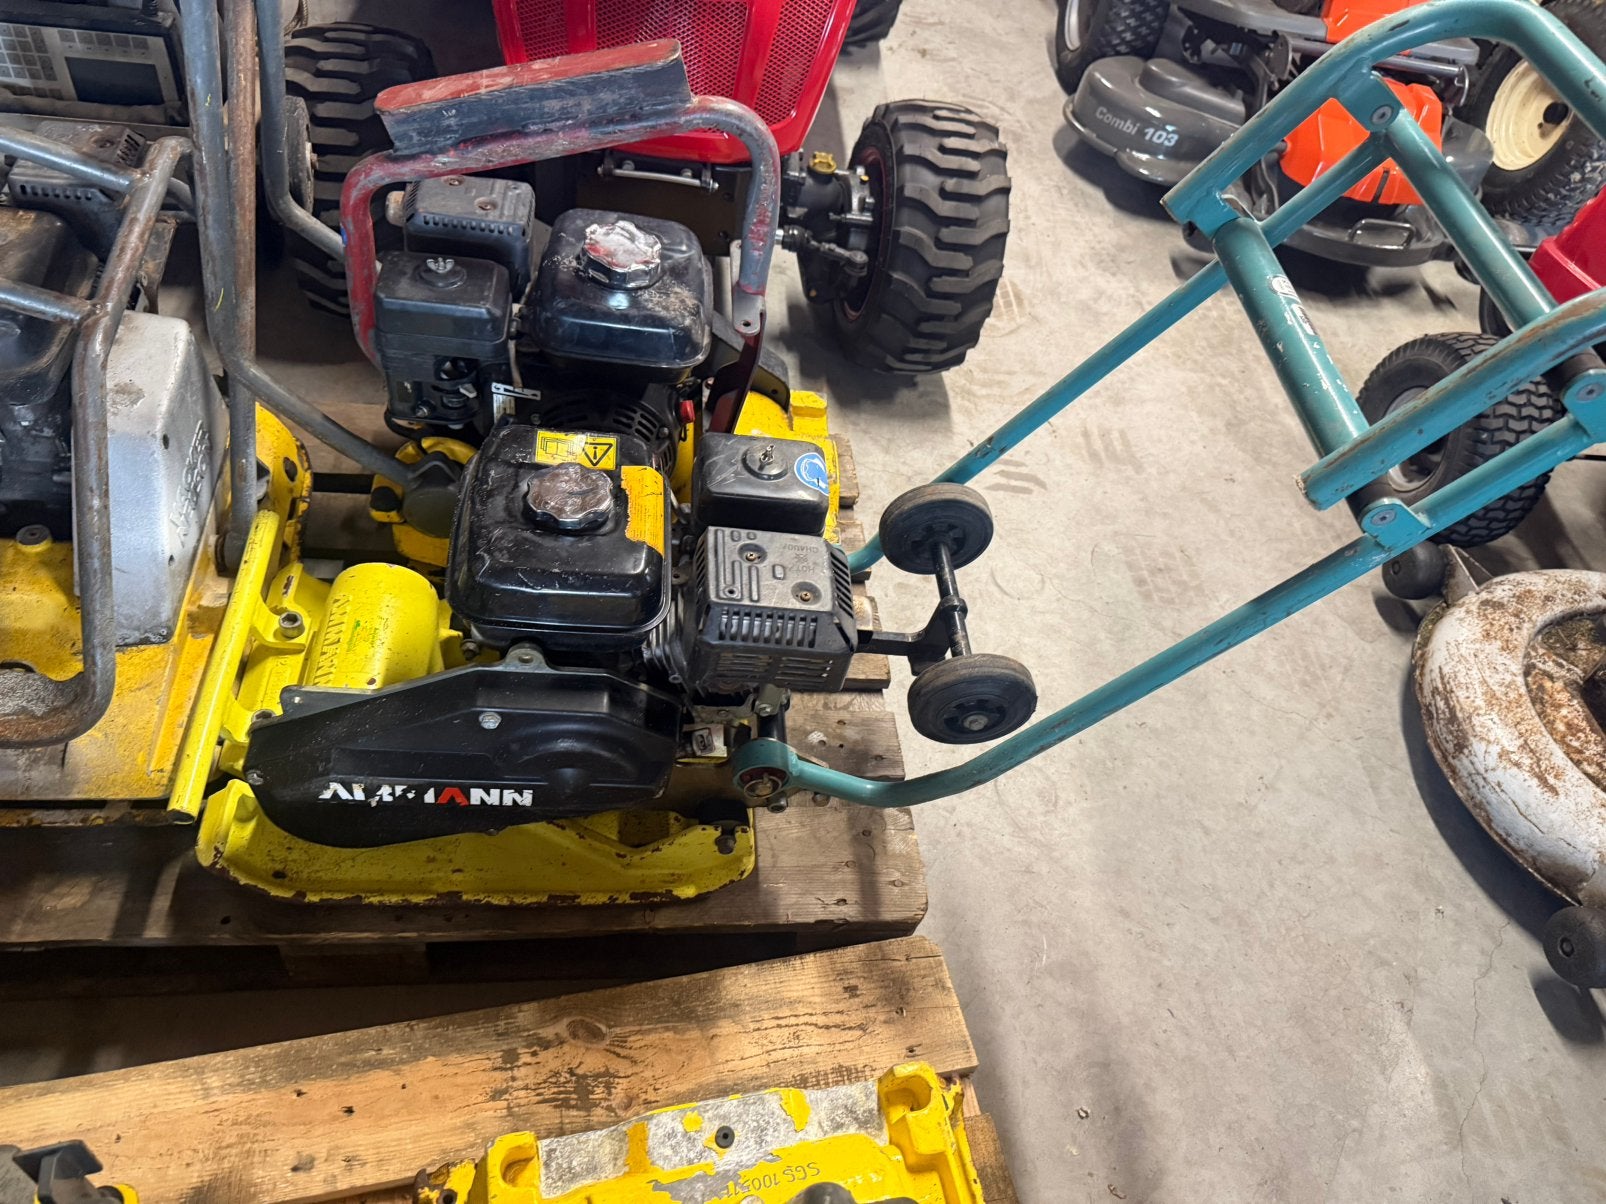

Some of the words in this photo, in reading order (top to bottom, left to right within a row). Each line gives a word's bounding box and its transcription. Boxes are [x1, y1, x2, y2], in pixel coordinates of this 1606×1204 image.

[1095, 106, 1140, 135] Combi
[1144, 127, 1179, 147] 103
[782, 1161, 821, 1183] SGS
